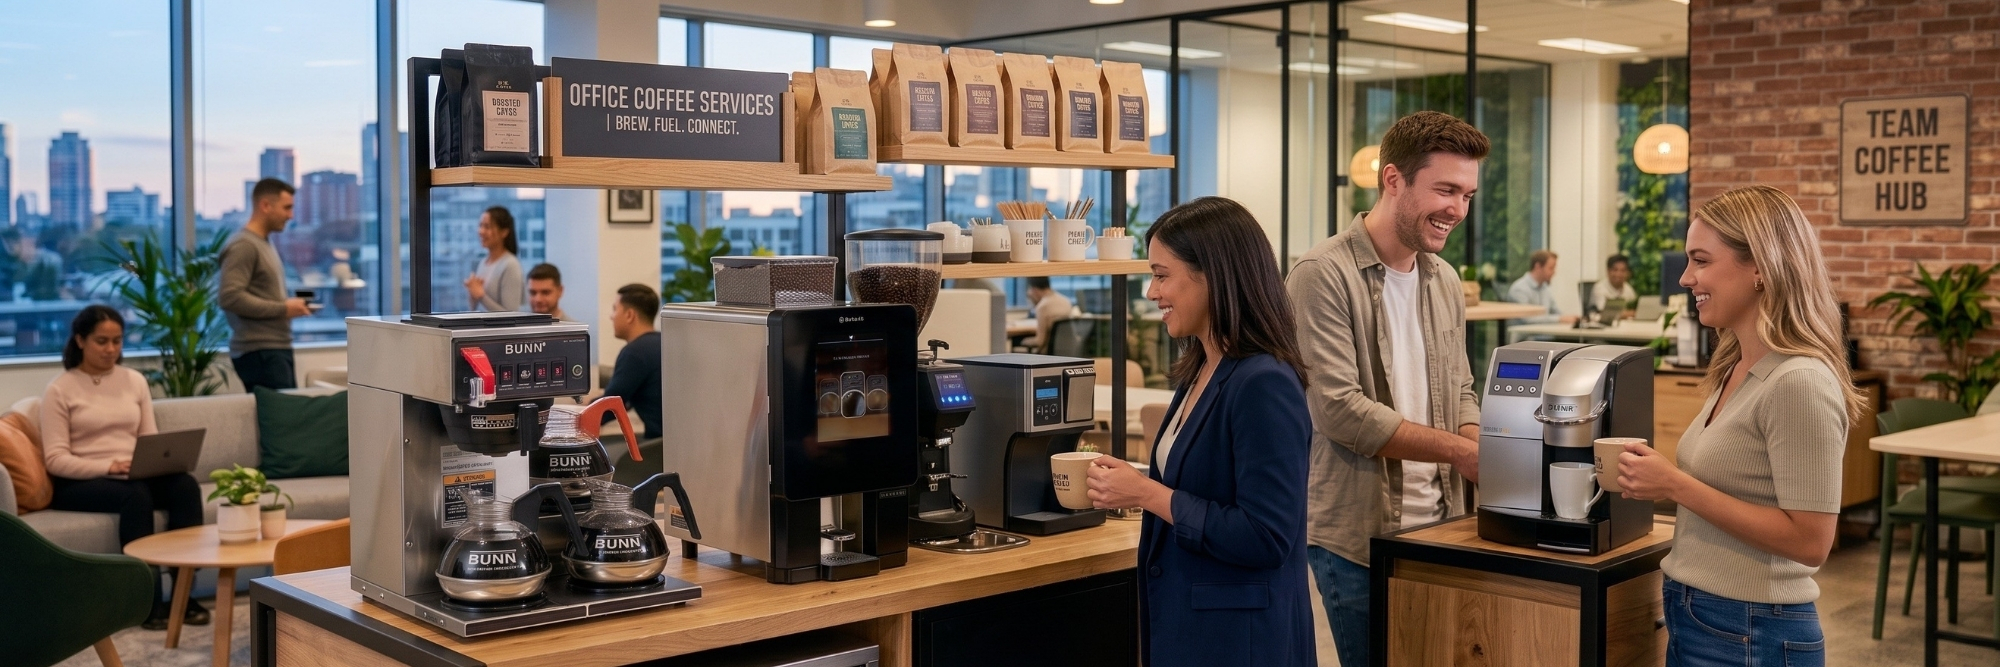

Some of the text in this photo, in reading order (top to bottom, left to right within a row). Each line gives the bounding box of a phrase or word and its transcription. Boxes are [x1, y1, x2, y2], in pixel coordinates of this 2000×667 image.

[570, 83, 774, 116] OFFICE COFFEE SERVICES
[616, 116, 651, 132] BREW.
[655, 117, 685, 133] FUEL.
[687, 118, 740, 135] CONNECT.
[1866, 107, 1939, 138] TEAM
[1855, 144, 1951, 175] COFFEE
[1875, 181, 1927, 211] HUB
[505, 343, 542, 354] BUNN
[550, 456, 590, 467] BUNN
[594, 538, 641, 549] BUNN
[468, 552, 516, 565] BUNN
